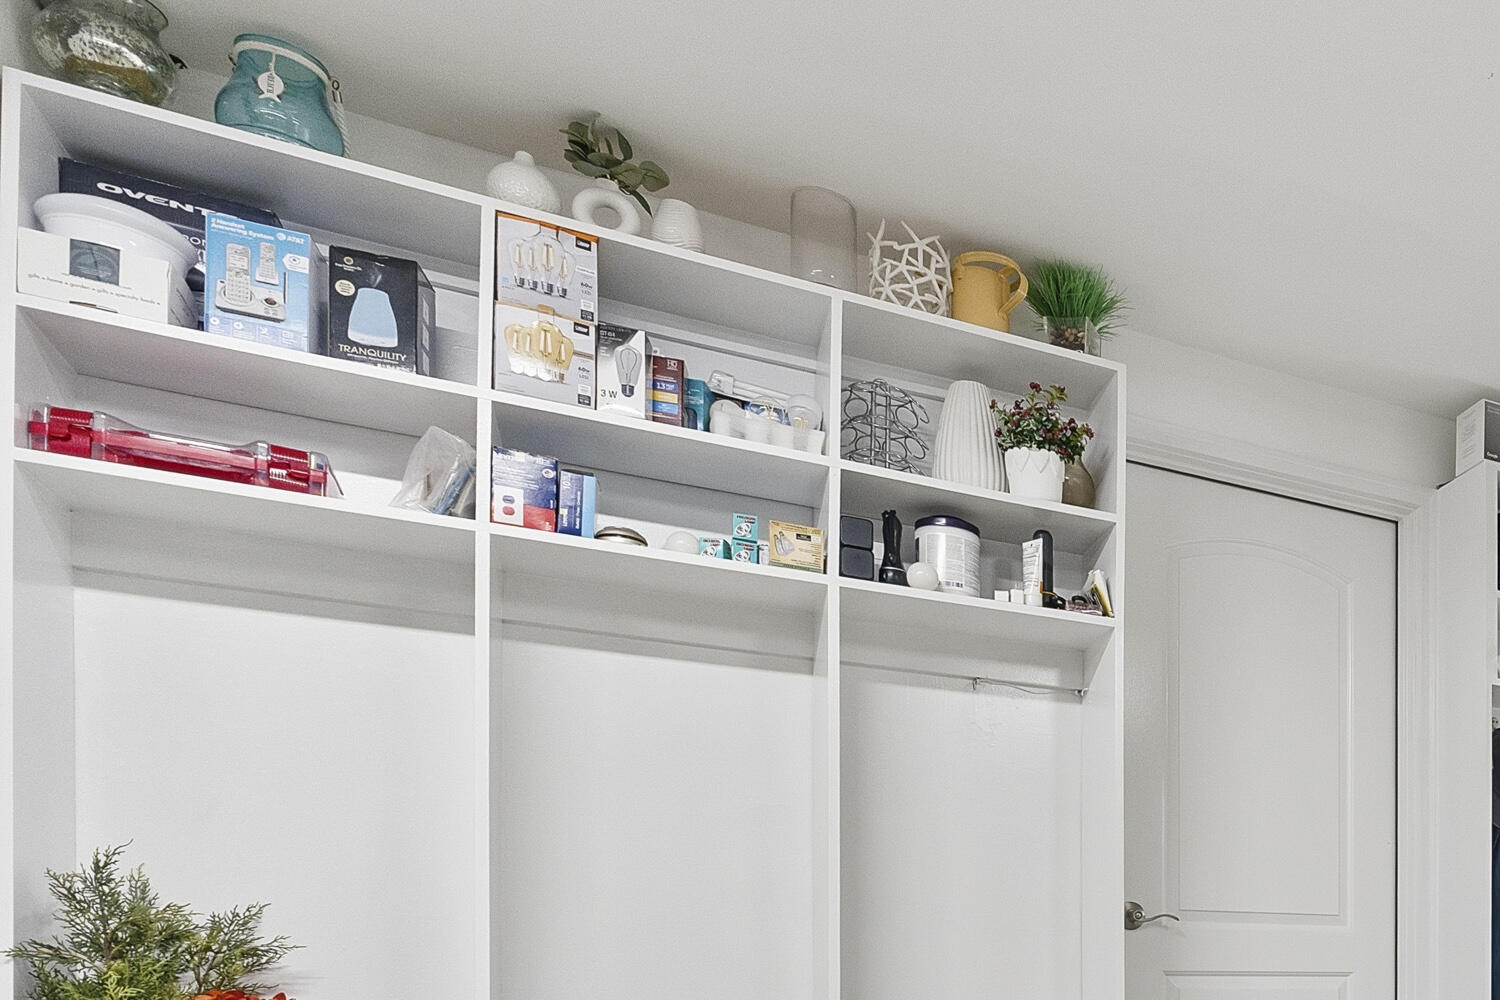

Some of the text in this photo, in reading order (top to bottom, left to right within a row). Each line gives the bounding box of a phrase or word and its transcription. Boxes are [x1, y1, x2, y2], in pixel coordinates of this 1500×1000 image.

[97, 182, 219, 217] OVENT
[338, 343, 407, 361] TRANQUILITY
[600, 389, 618, 399] 3 W
